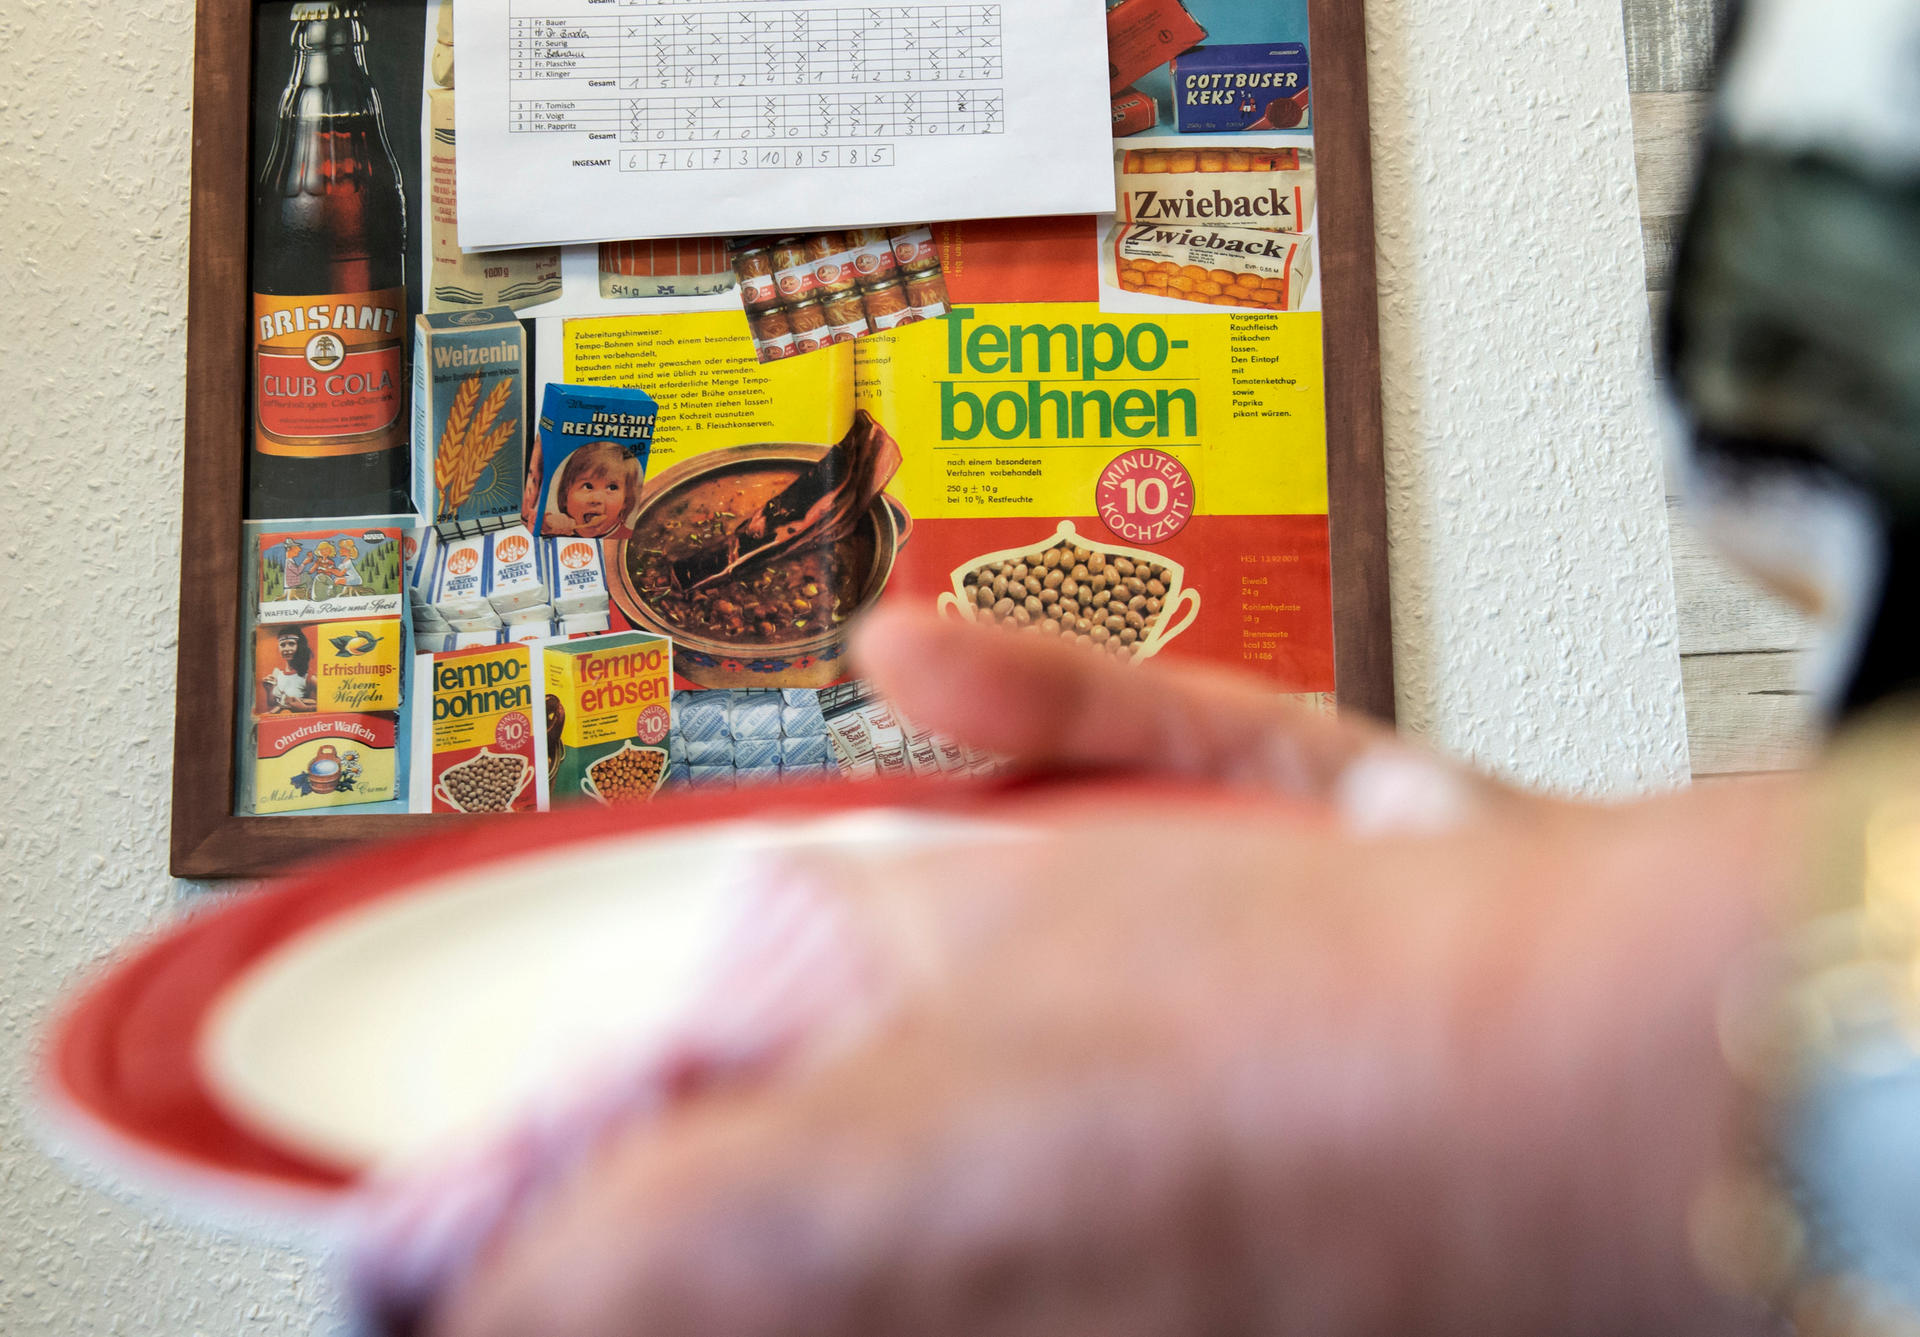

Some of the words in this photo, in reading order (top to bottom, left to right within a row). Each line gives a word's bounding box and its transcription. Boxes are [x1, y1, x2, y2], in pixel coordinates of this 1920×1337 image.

[588, 80, 616, 88] Gesamt
[1186, 72, 1298, 89] COTTBUSER
[1186, 90, 1236, 105] KEKS
[546, 112, 565, 121] Voigt
[547, 123, 577, 132] Pappritz
[588, 133, 617, 142] Gesamt
[572, 159, 611, 167] INGESAMT
[629, 155, 637, 168] 6
[658, 154, 667, 168] 7
[686, 153, 693, 168] 6
[712, 150, 721, 164] 7
[738, 151, 749, 165] 3
[761, 151, 780, 165] 10
[795, 151, 803, 165] 8
[818, 150, 829, 163] 5
[850, 150, 857, 164] 8
[872, 148, 886, 163] 5
[1135, 188, 1291, 219] Zwieback
[1128, 224, 1285, 259] Zwieback
[611, 284, 628, 294] 541
[260, 305, 398, 341] BRISANT
[1230, 313, 1278, 321] Vorgegartes
[575, 329, 663, 340] Zubereitungshinweise:
[575, 341, 634, 350] Tempo-Bohnen
[637, 339, 653, 347] sind
[704, 335, 751, 343] besonderen
[936, 306, 1189, 381] Tempo-
[433, 341, 519, 368] Weizenin
[575, 353, 601, 361] fahren
[1251, 356, 1279, 364] Eintopf
[575, 363, 612, 372] brauchen
[636, 360, 655, 368] mehr
[659, 359, 701, 368] gewaschen
[726, 356, 758, 365] eingewe
[588, 373, 616, 381] werden
[673, 370, 696, 378] üblich
[712, 367, 756, 375] verwenden.
[1232, 377, 1296, 385] Tomatenketchup
[264, 375, 317, 397] CLUB
[325, 370, 393, 396] COLA
[659, 379, 708, 388] erforderliche
[712, 378, 739, 387] Menge
[742, 376, 772, 385] Tempo-
[701, 389, 725, 397] Brühe
[728, 388, 765, 396] ansetzen,
[680, 401, 713, 409] Minuten
[716, 399, 741, 407] ziehen
[744, 397, 773, 406] lassen!
[1232, 399, 1263, 407] Paprika
[680, 412, 712, 420] Kochzeit
[715, 410, 754, 418] ausnutzen
[941, 381, 1198, 441] bohnen
[1233, 409, 1258, 418] pikant
[1261, 409, 1291, 417] würzen.
[592, 411, 655, 426] instant
[707, 420, 774, 430] Fleischkonserven,
[562, 421, 651, 438] REISMEHL
[651, 436, 677, 444] geben,
[947, 458, 965, 466] nach
[946, 469, 985, 477] Verfahren
[990, 468, 1042, 476] vorbehandelt
[1102, 453, 1186, 491] MINUTEN
[1120, 478, 1168, 515] 10
[1101, 498, 1188, 540] KOCHZEIT
[1242, 576, 1267, 585] Eiweiß
[264, 609, 299, 617] WAFFELN
[1242, 603, 1301, 612] Kohlenhydrate
[1243, 629, 1288, 637] Brennwerte
[323, 662, 396, 677] Erfrischungs-
[576, 649, 675, 682] Tempo-
[433, 659, 527, 692] Tempo-
[333, 690, 383, 708] Waffeln
[581, 676, 669, 712] erbsen
[433, 684, 531, 720] bohnen
[504, 723, 522, 740] 10
[646, 716, 662, 733] 10
[275, 721, 333, 750] Ohrdrufer
[334, 721, 376, 742] Waffeln
